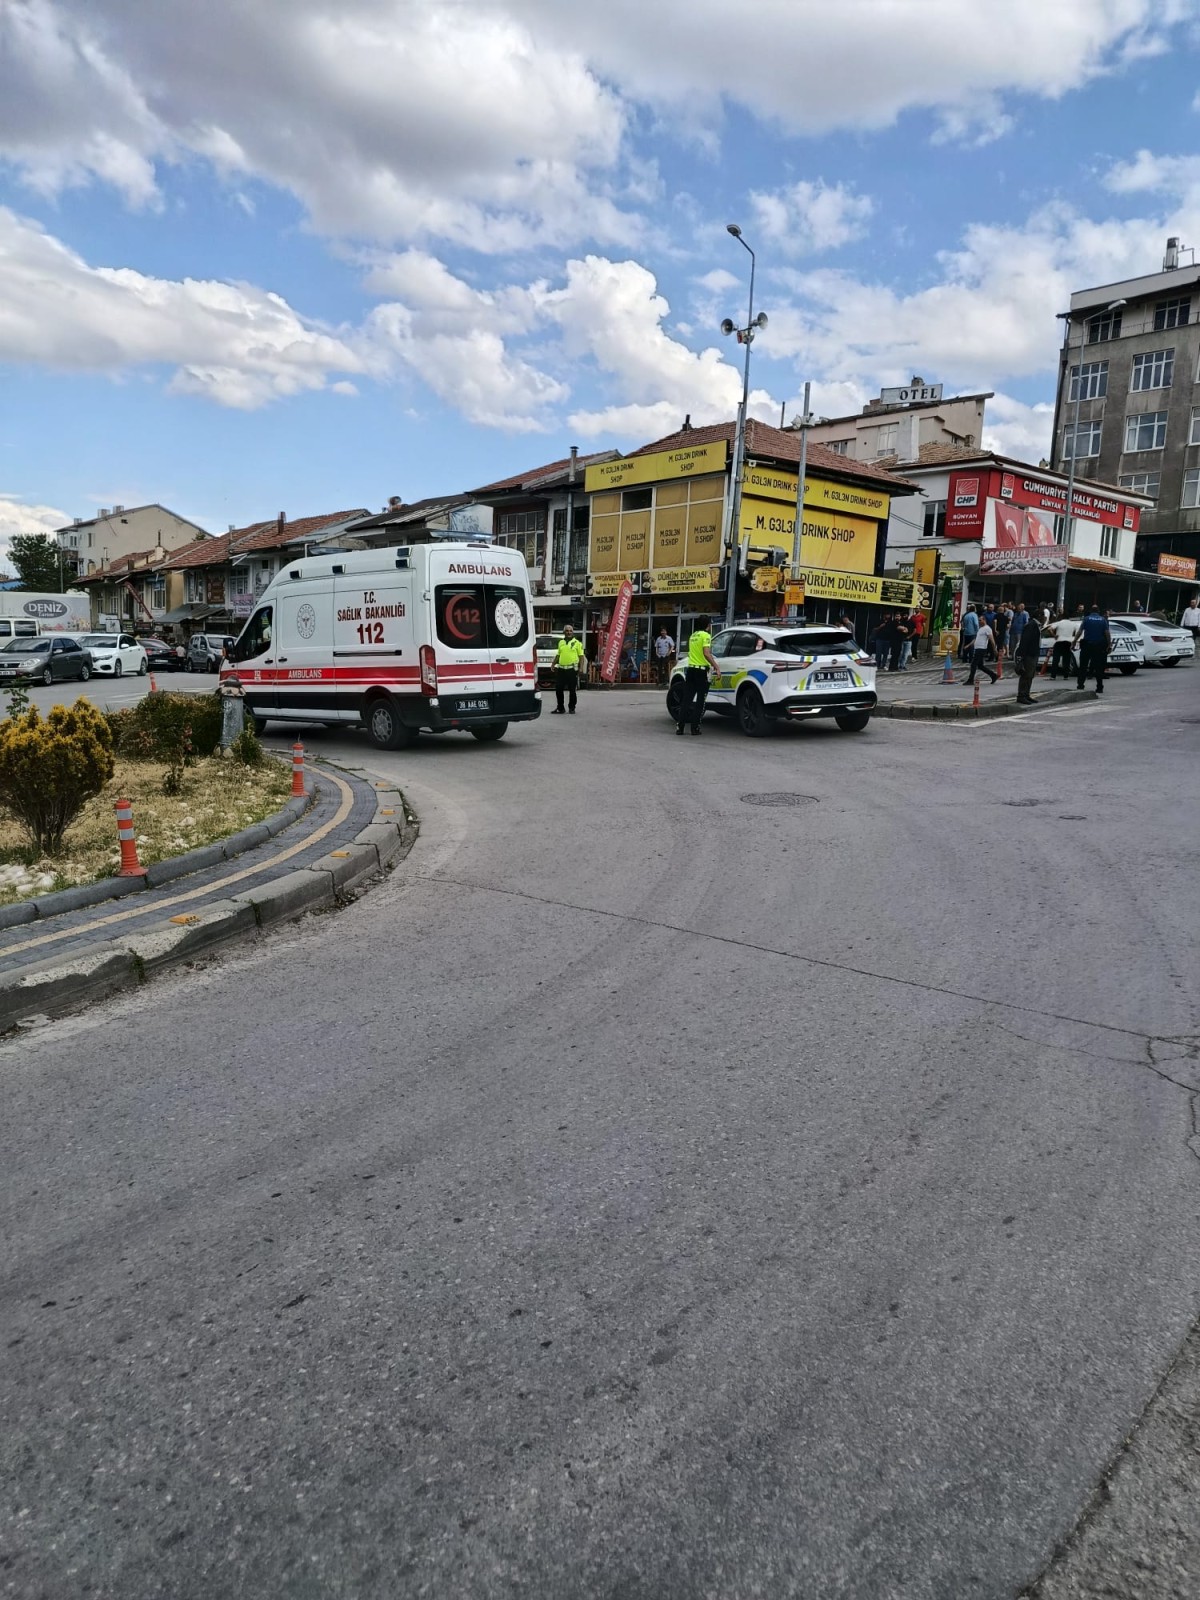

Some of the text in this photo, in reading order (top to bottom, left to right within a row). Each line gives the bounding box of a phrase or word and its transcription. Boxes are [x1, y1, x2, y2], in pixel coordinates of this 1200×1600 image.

[900, 388, 937, 400] OTEL
[692, 449, 707, 459] DRINK
[680, 462, 694, 472] SHOP
[610, 475, 623, 483] SHOP
[773, 479, 792, 491] DRINK
[793, 484, 810, 494] SOP
[850, 494, 867, 505] DRINK
[868, 499, 882, 509] SHOP
[957, 496, 975, 504] CHP
[1073, 493, 1091, 506] HALK
[1093, 499, 1118, 513] PARTİSİ
[1041, 499, 1061, 509] BÜNYAN
[1074, 507, 1100, 519] BAŞKANLIĞI
[756, 515, 766, 530] M.
[802, 523, 829, 539] DRINK
[832, 528, 855, 542] SHOP
[983, 549, 1026, 560] HOCAOĞLU
[448, 563, 512, 577] AMBULANS
[658, 570, 707, 581] DÜRÜM DÜNYASI
[800, 571, 834, 588] DÜRÜM
[838, 576, 877, 593] DÜNYASI
[364, 591, 376, 604] T.C.
[29, 602, 62, 613] DENİZ
[337, 602, 405, 621] SAĞLIK BAKANLIĞI
[454, 609, 480, 623] 112
[357, 622, 384, 644] 112
[288, 669, 322, 679] AMBULANS
[459, 701, 466, 709] 38
